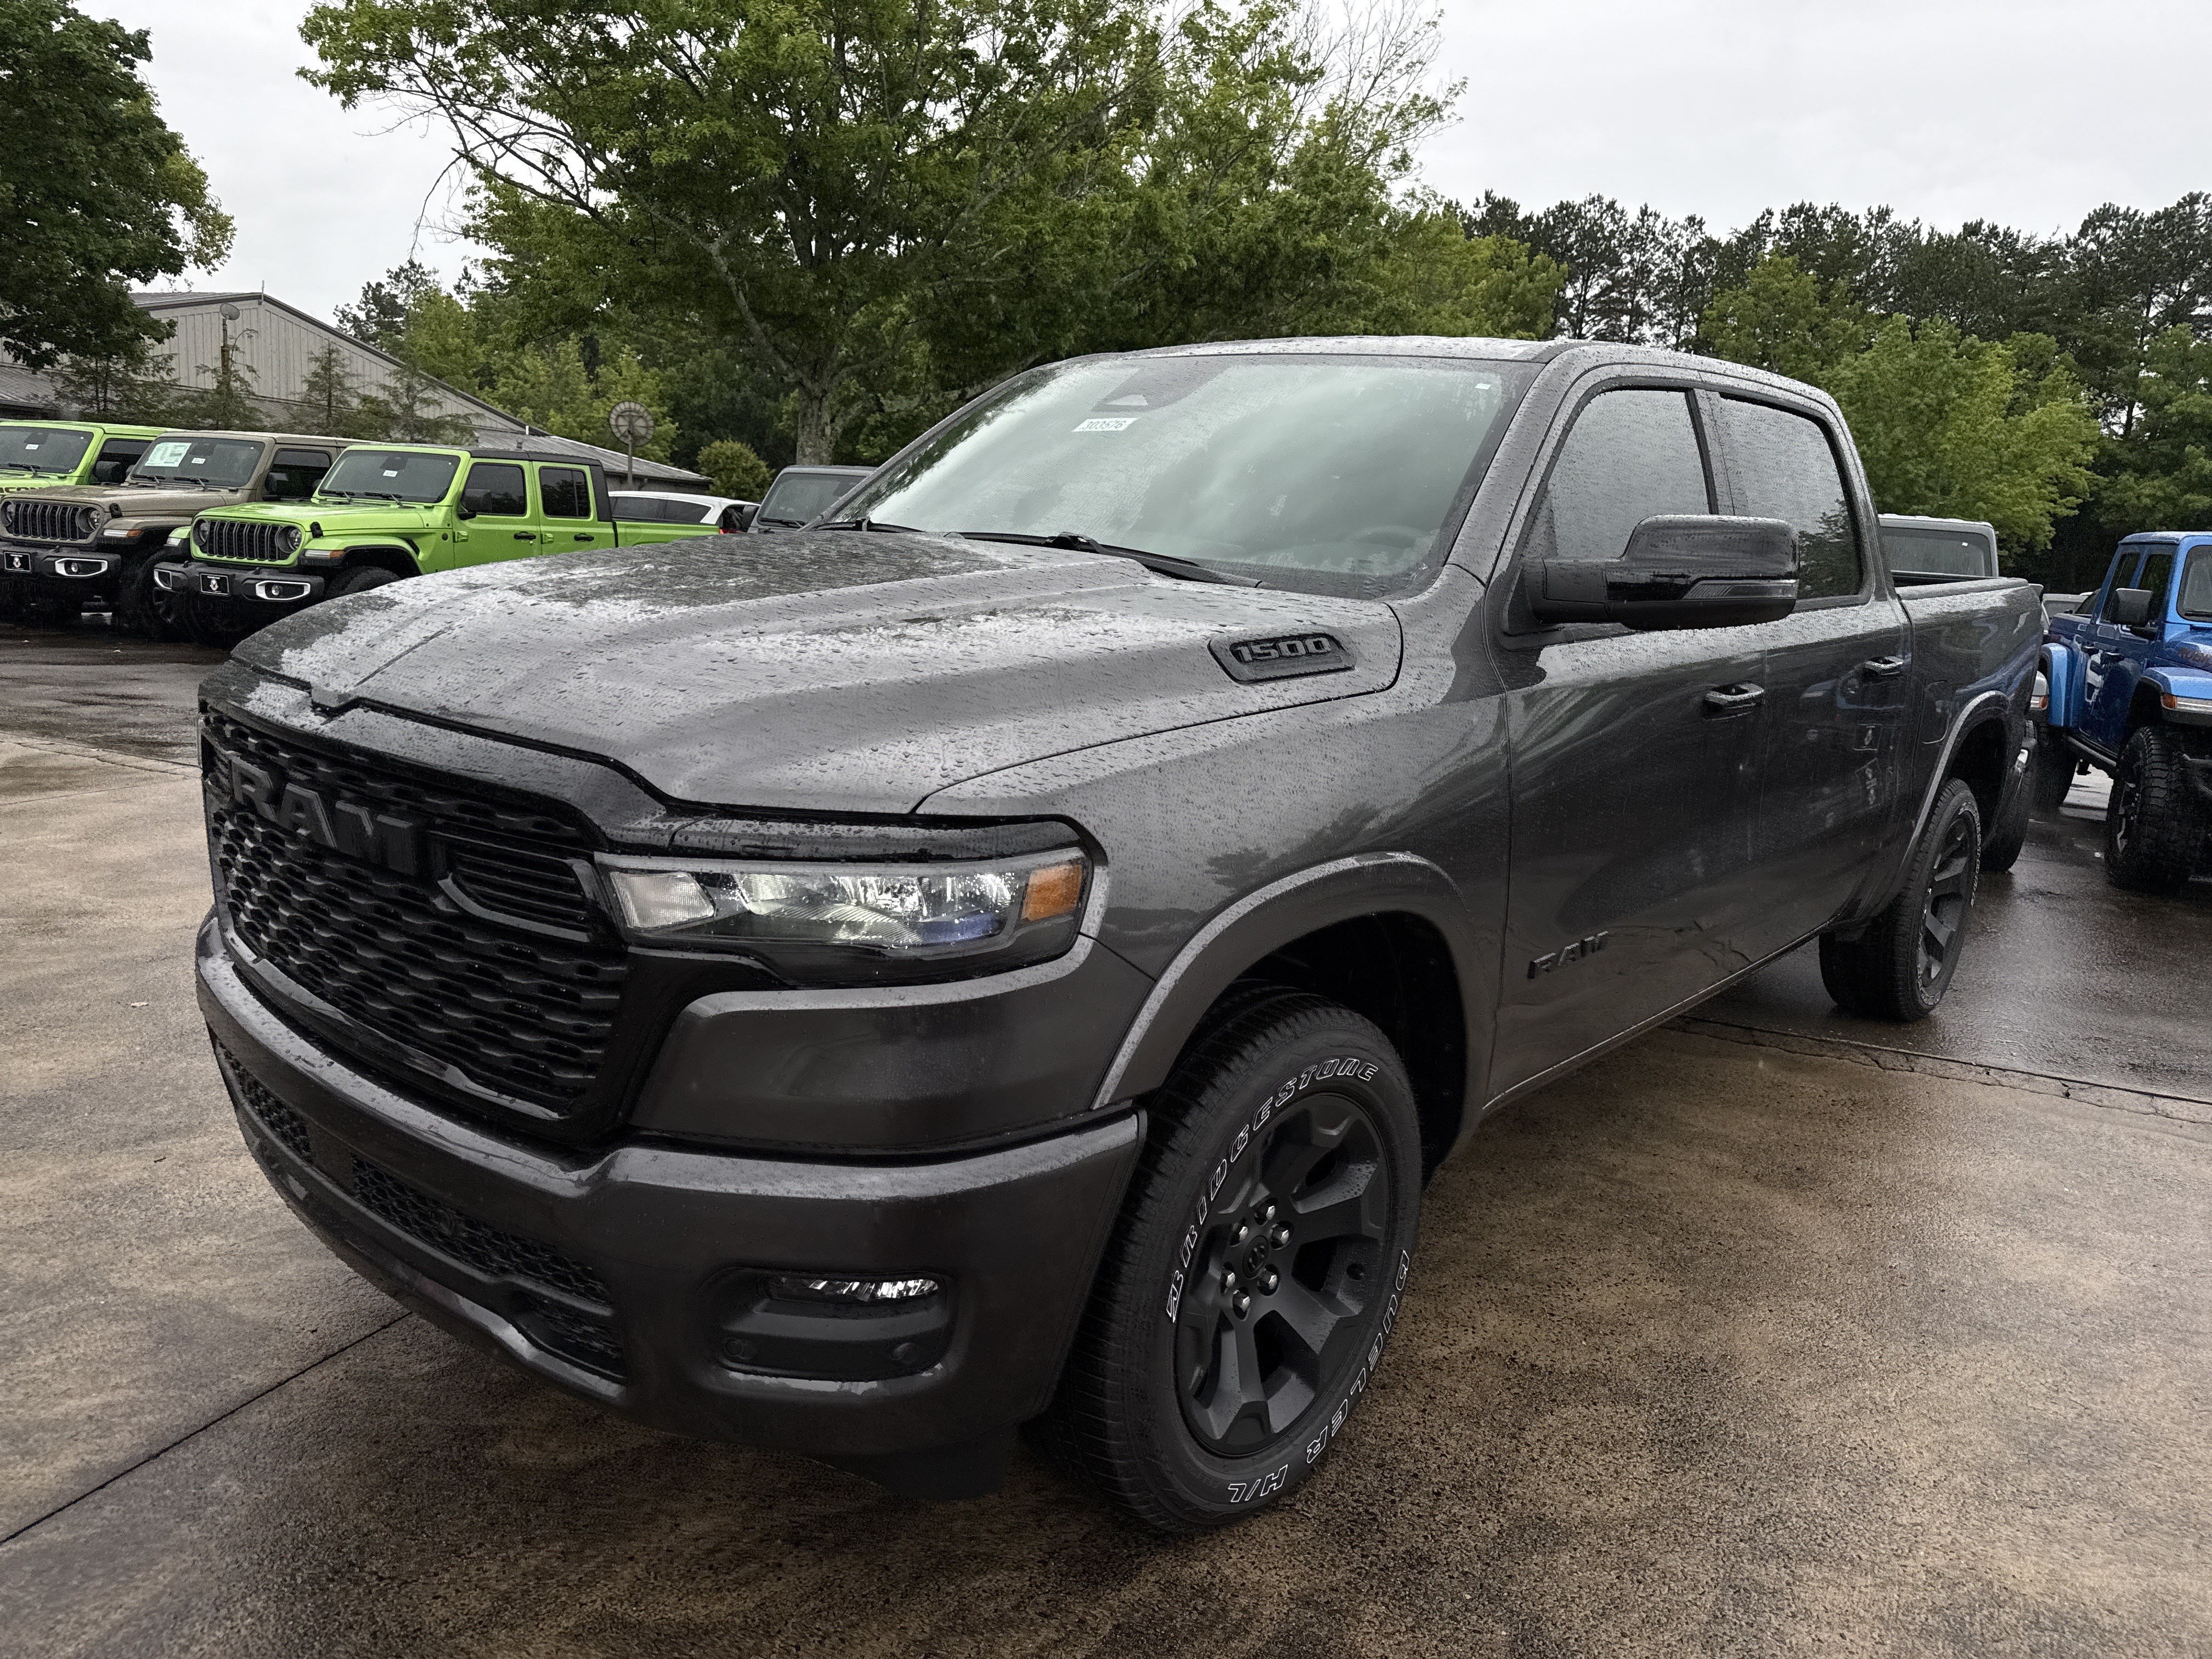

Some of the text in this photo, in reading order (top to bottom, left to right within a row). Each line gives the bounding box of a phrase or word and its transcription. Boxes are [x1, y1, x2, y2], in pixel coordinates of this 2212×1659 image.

[1234, 637, 1332, 662] 1500
[231, 755, 415, 877] RAM
[1527, 930, 1609, 979] RAM
[1167, 1059, 1379, 1322] BRIDGESTONE
[1228, 1250, 1410, 1502] DUELER H/L
